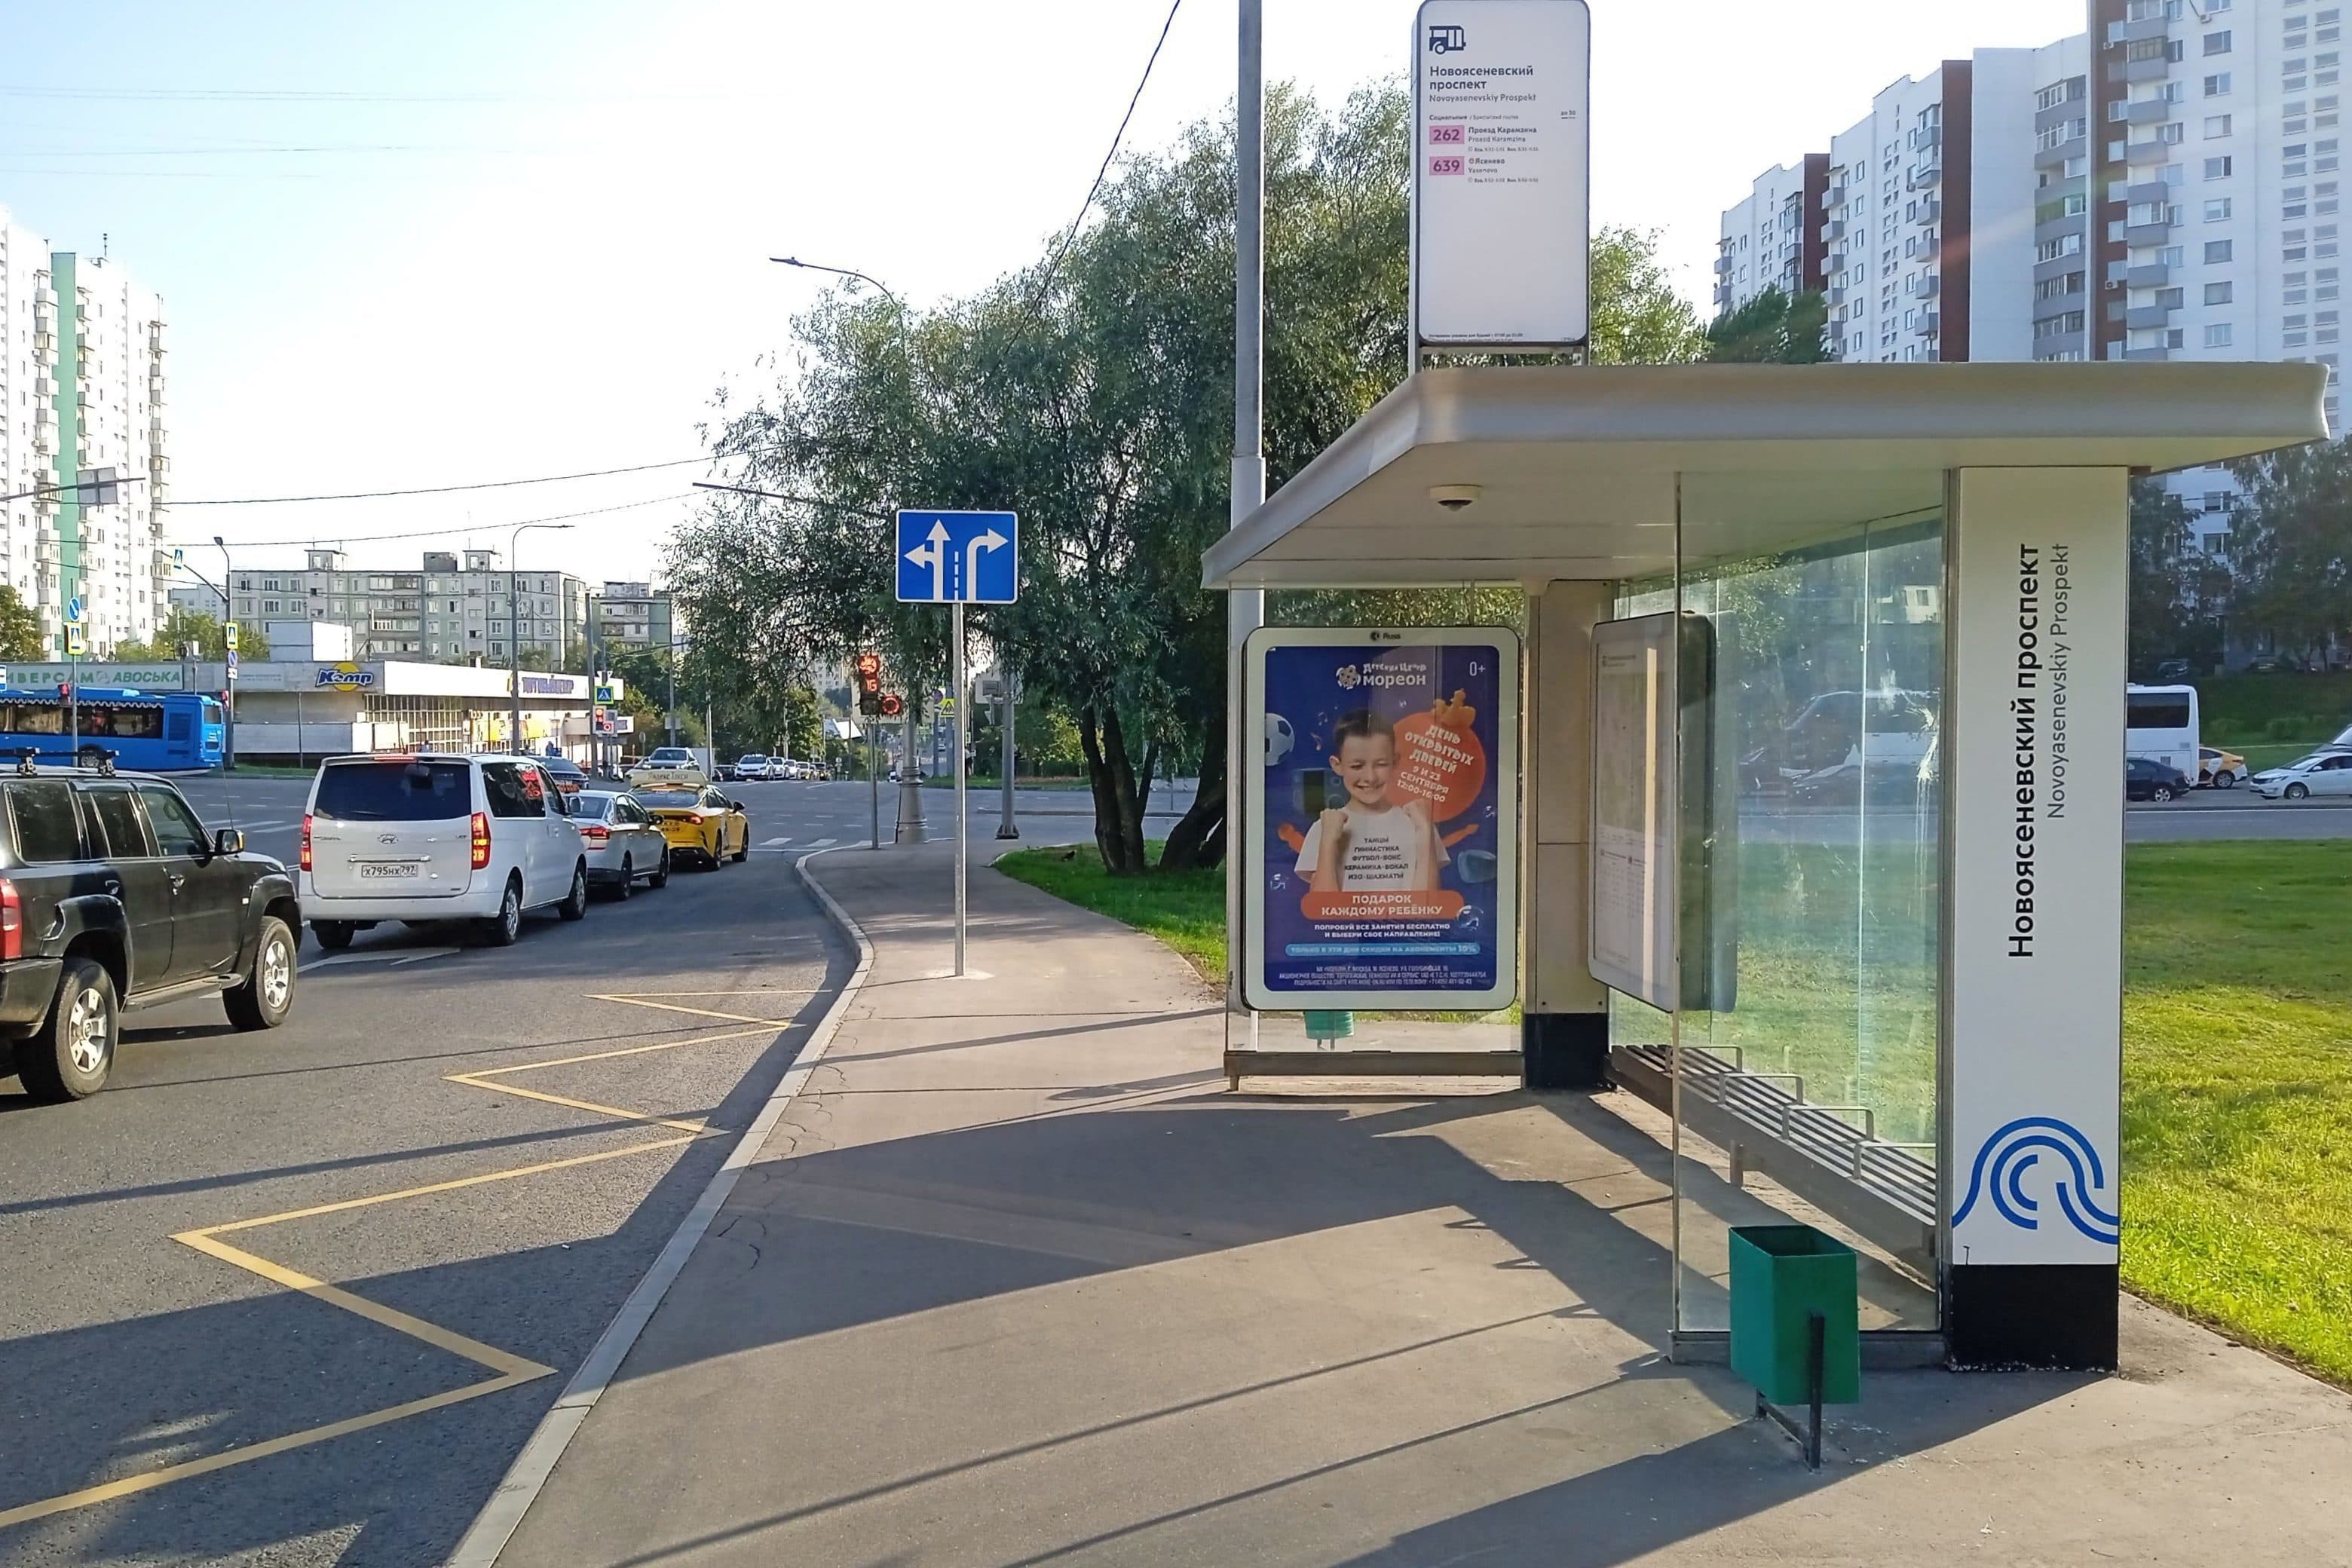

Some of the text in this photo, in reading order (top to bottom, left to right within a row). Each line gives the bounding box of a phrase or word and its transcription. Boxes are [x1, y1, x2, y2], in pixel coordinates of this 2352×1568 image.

[1430, 66, 1533, 76] Новоясеневский
[1430, 81, 1487, 91] проспект
[1429, 93, 1536, 103] Novoyasenevskiy Prospekt
[1434, 129, 1459, 141] 262
[1433, 161, 1460, 172] 639
[1469, 661, 1486, 676] 0+
[113, 671, 180, 682] АВОСЬКА
[1363, 675, 1426, 688] мореон
[2047, 544, 2072, 819] Novoyasenevskiy Prospekt
[1426, 724, 1461, 744] ДЕНЬ
[1404, 731, 1475, 765] ОТКРЫТЫХ
[2009, 544, 2043, 957] Новоясеневский проспект
[1409, 749, 1458, 774] ДВЕРЕЙ
[1420, 767, 1429, 776] И
[1401, 771, 1449, 794] СЕНТЯБРЯ
[1352, 895, 1412, 905] ПОДАРОК
[1321, 904, 1443, 917] КАЖДОМУ РЕБЁНКУ
